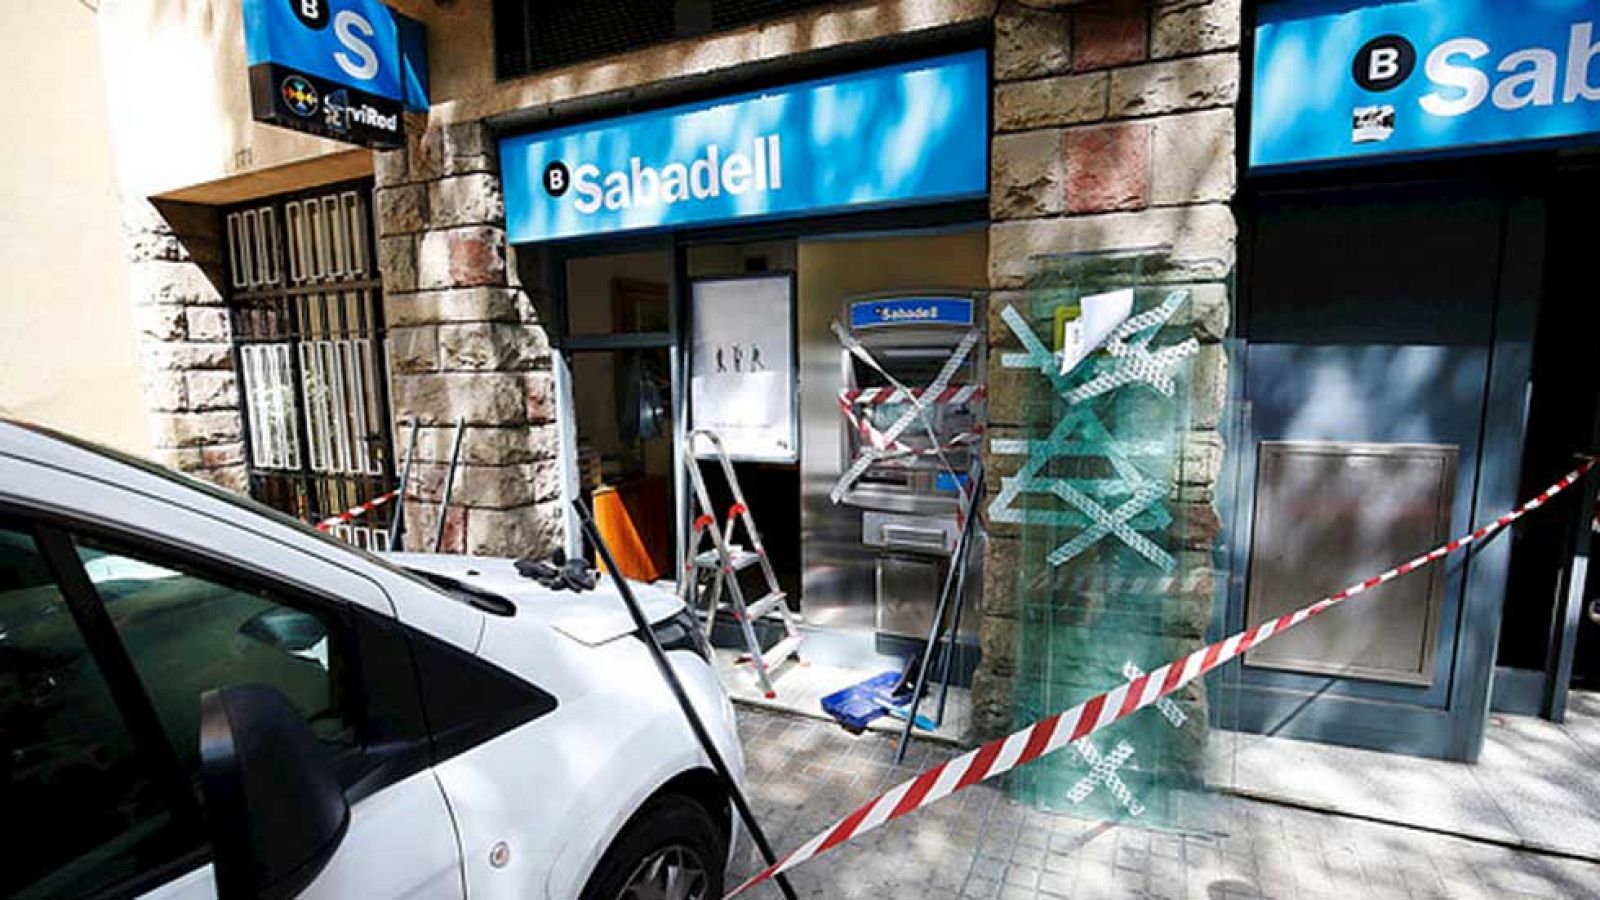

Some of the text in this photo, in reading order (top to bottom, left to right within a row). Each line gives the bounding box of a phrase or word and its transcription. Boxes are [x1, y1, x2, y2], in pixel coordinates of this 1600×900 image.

[333, 10, 380, 80] S
[1368, 48, 1400, 81] B
[549, 134, 782, 215] B Sabadell
